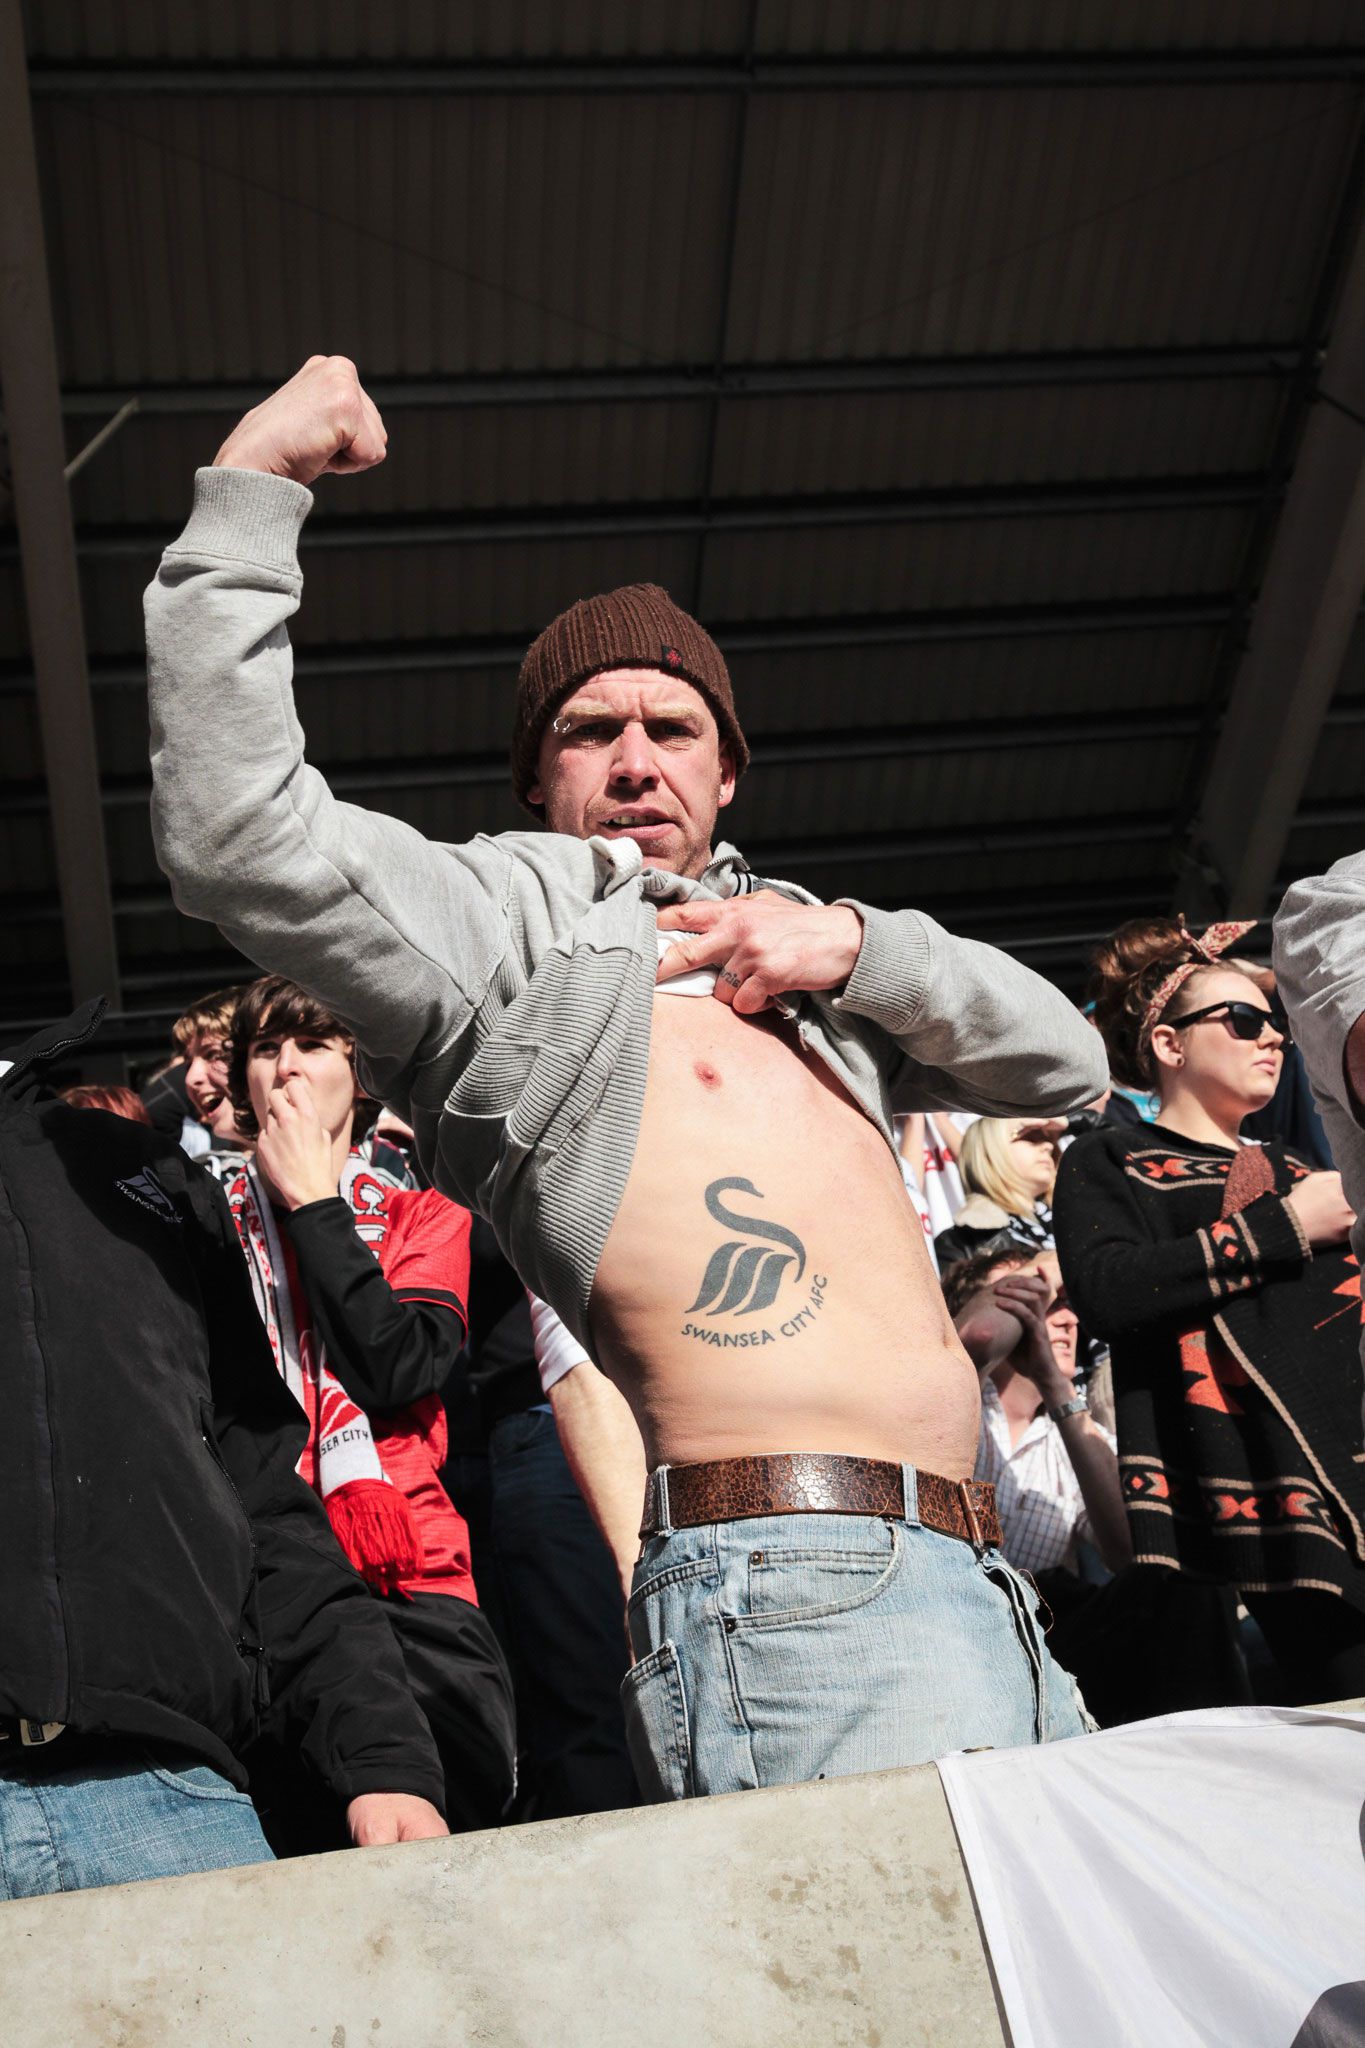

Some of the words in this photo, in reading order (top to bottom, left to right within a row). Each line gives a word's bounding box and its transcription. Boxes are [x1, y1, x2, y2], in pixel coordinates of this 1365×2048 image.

[681, 1323, 775, 1348] SWANSEA
[780, 1306, 817, 1338] CITY
[809, 1274, 828, 1310] AFC
[342, 1429, 369, 1442] CITY
